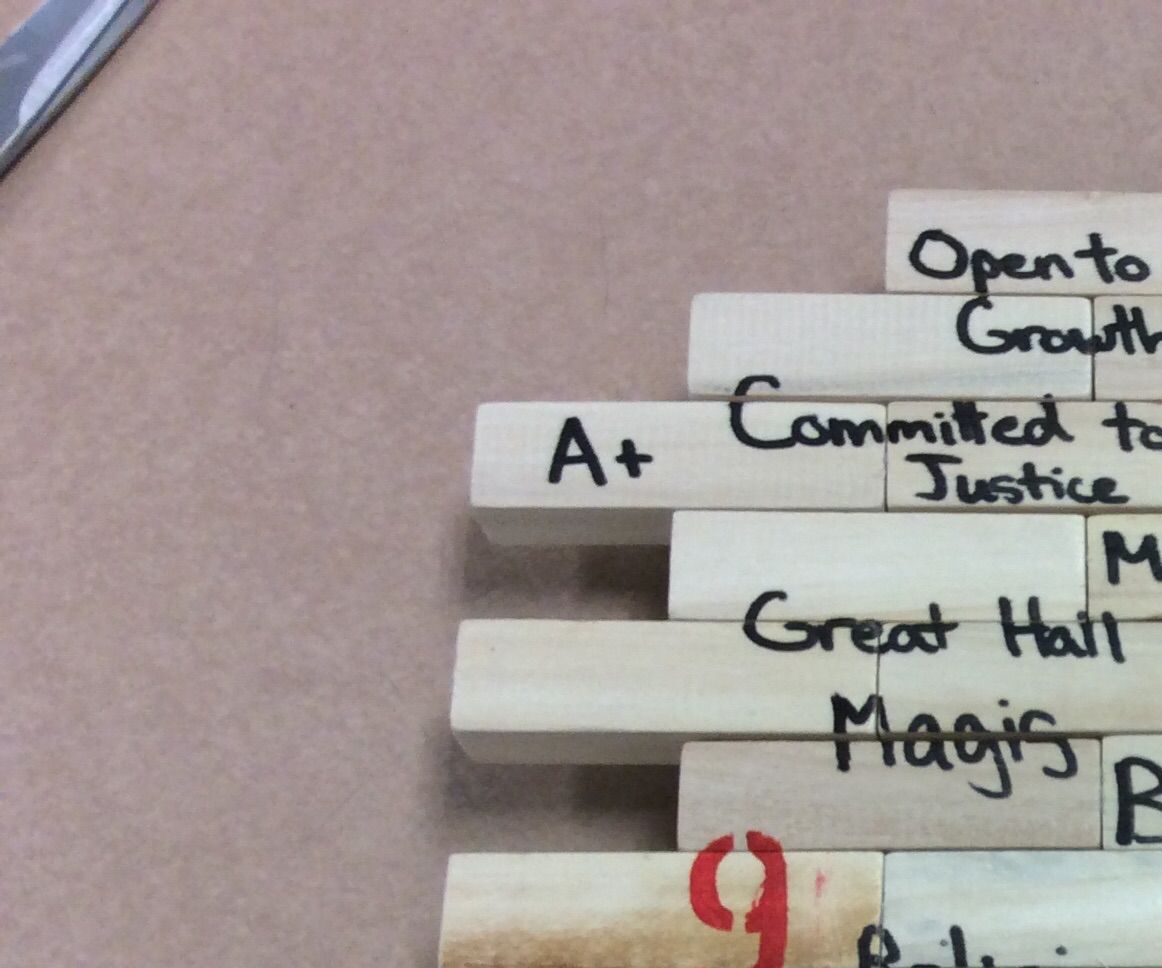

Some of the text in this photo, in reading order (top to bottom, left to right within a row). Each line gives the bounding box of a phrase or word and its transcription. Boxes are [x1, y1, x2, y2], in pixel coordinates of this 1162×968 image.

[909, 229, 1151, 294] Open to
[729, 375, 1073, 449] Committed
[547, 417, 654, 486] A+
[906, 452, 1131, 504] Justice
[742, 591, 1125, 662] Great Hall
[831, 694, 1078, 798] Magis
